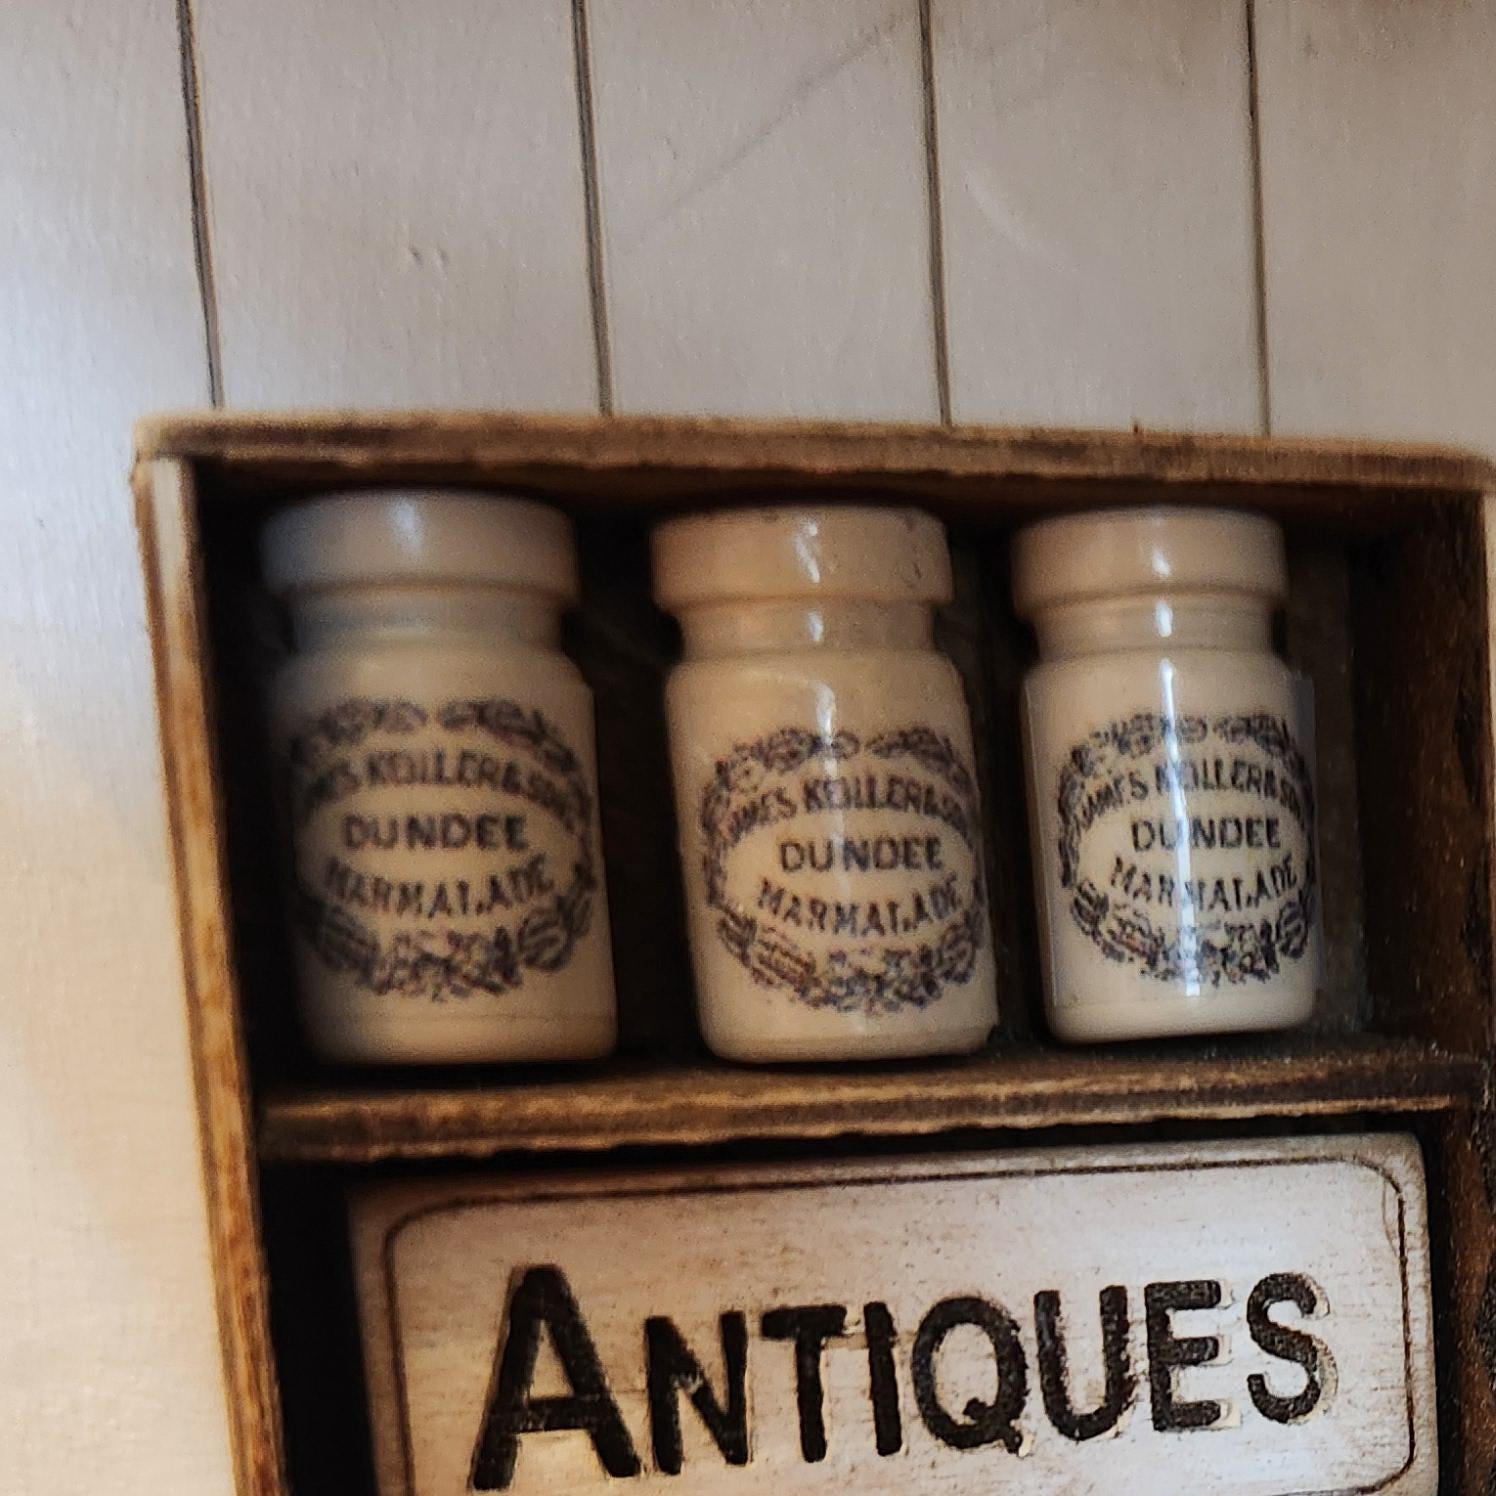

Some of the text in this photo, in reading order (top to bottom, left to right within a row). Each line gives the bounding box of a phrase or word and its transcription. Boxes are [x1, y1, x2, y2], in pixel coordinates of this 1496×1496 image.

[343, 813, 530, 850] DUNDEE
[1130, 816, 1281, 852] DUNDEE
[778, 834, 943, 873] DUNDEE
